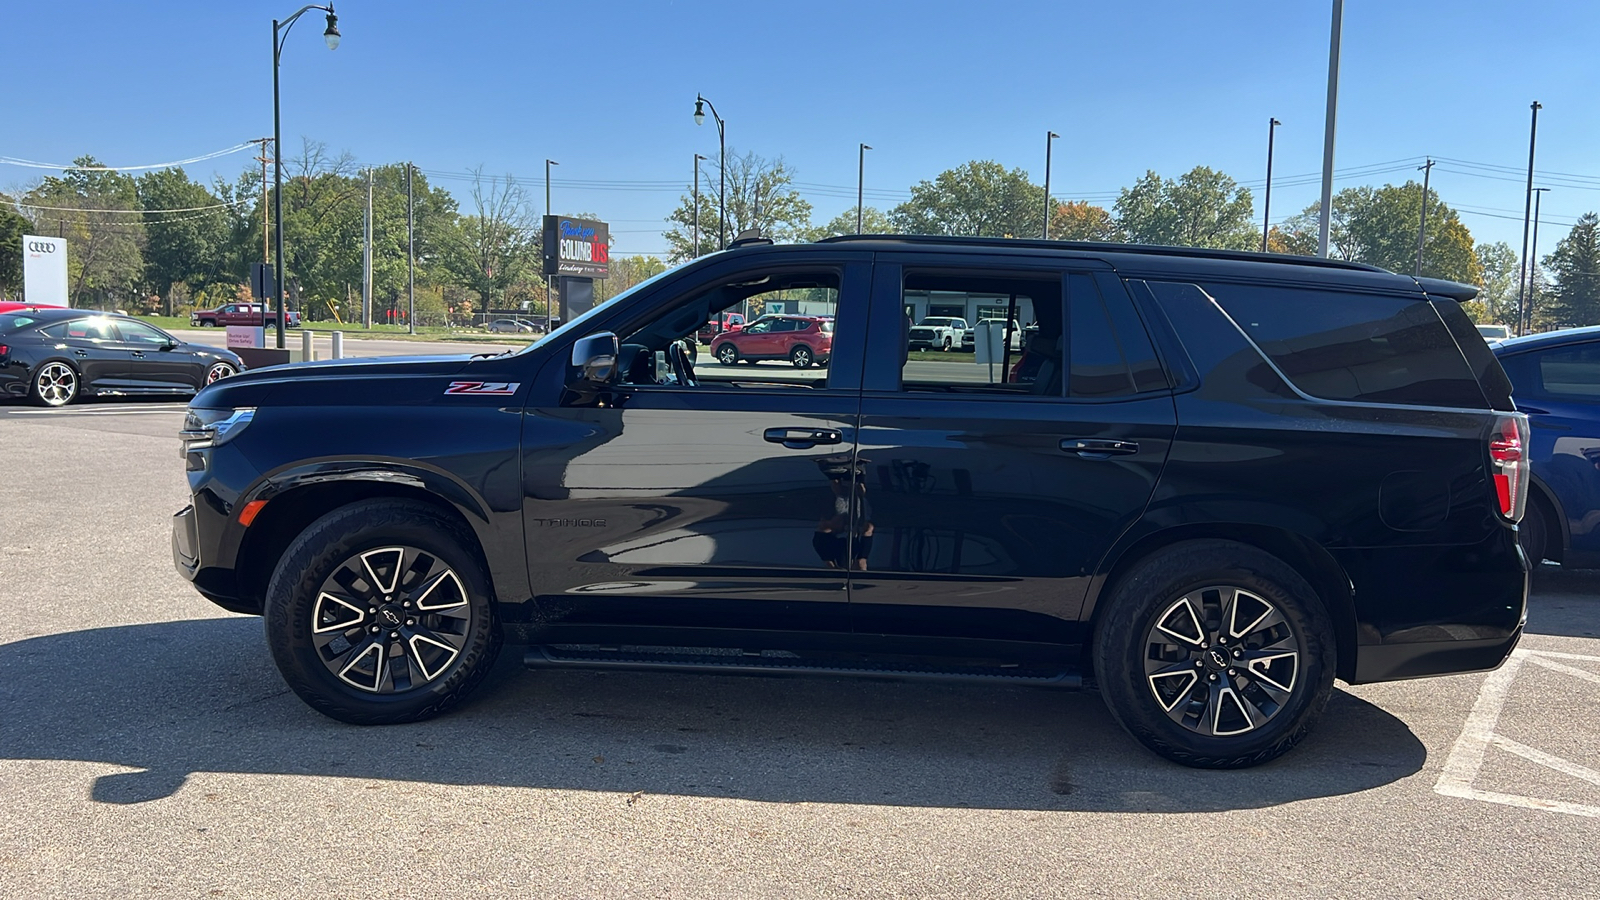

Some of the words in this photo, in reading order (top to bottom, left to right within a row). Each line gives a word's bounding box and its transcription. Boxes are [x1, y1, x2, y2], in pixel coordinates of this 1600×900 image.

[560, 220, 582, 239] Thank
[583, 228, 595, 242] you
[560, 239, 608, 263] COLUMBUS
[443, 381, 521, 395] Z71
[533, 518, 607, 528] TAHOE
[443, 603, 489, 691] WRANGLER
